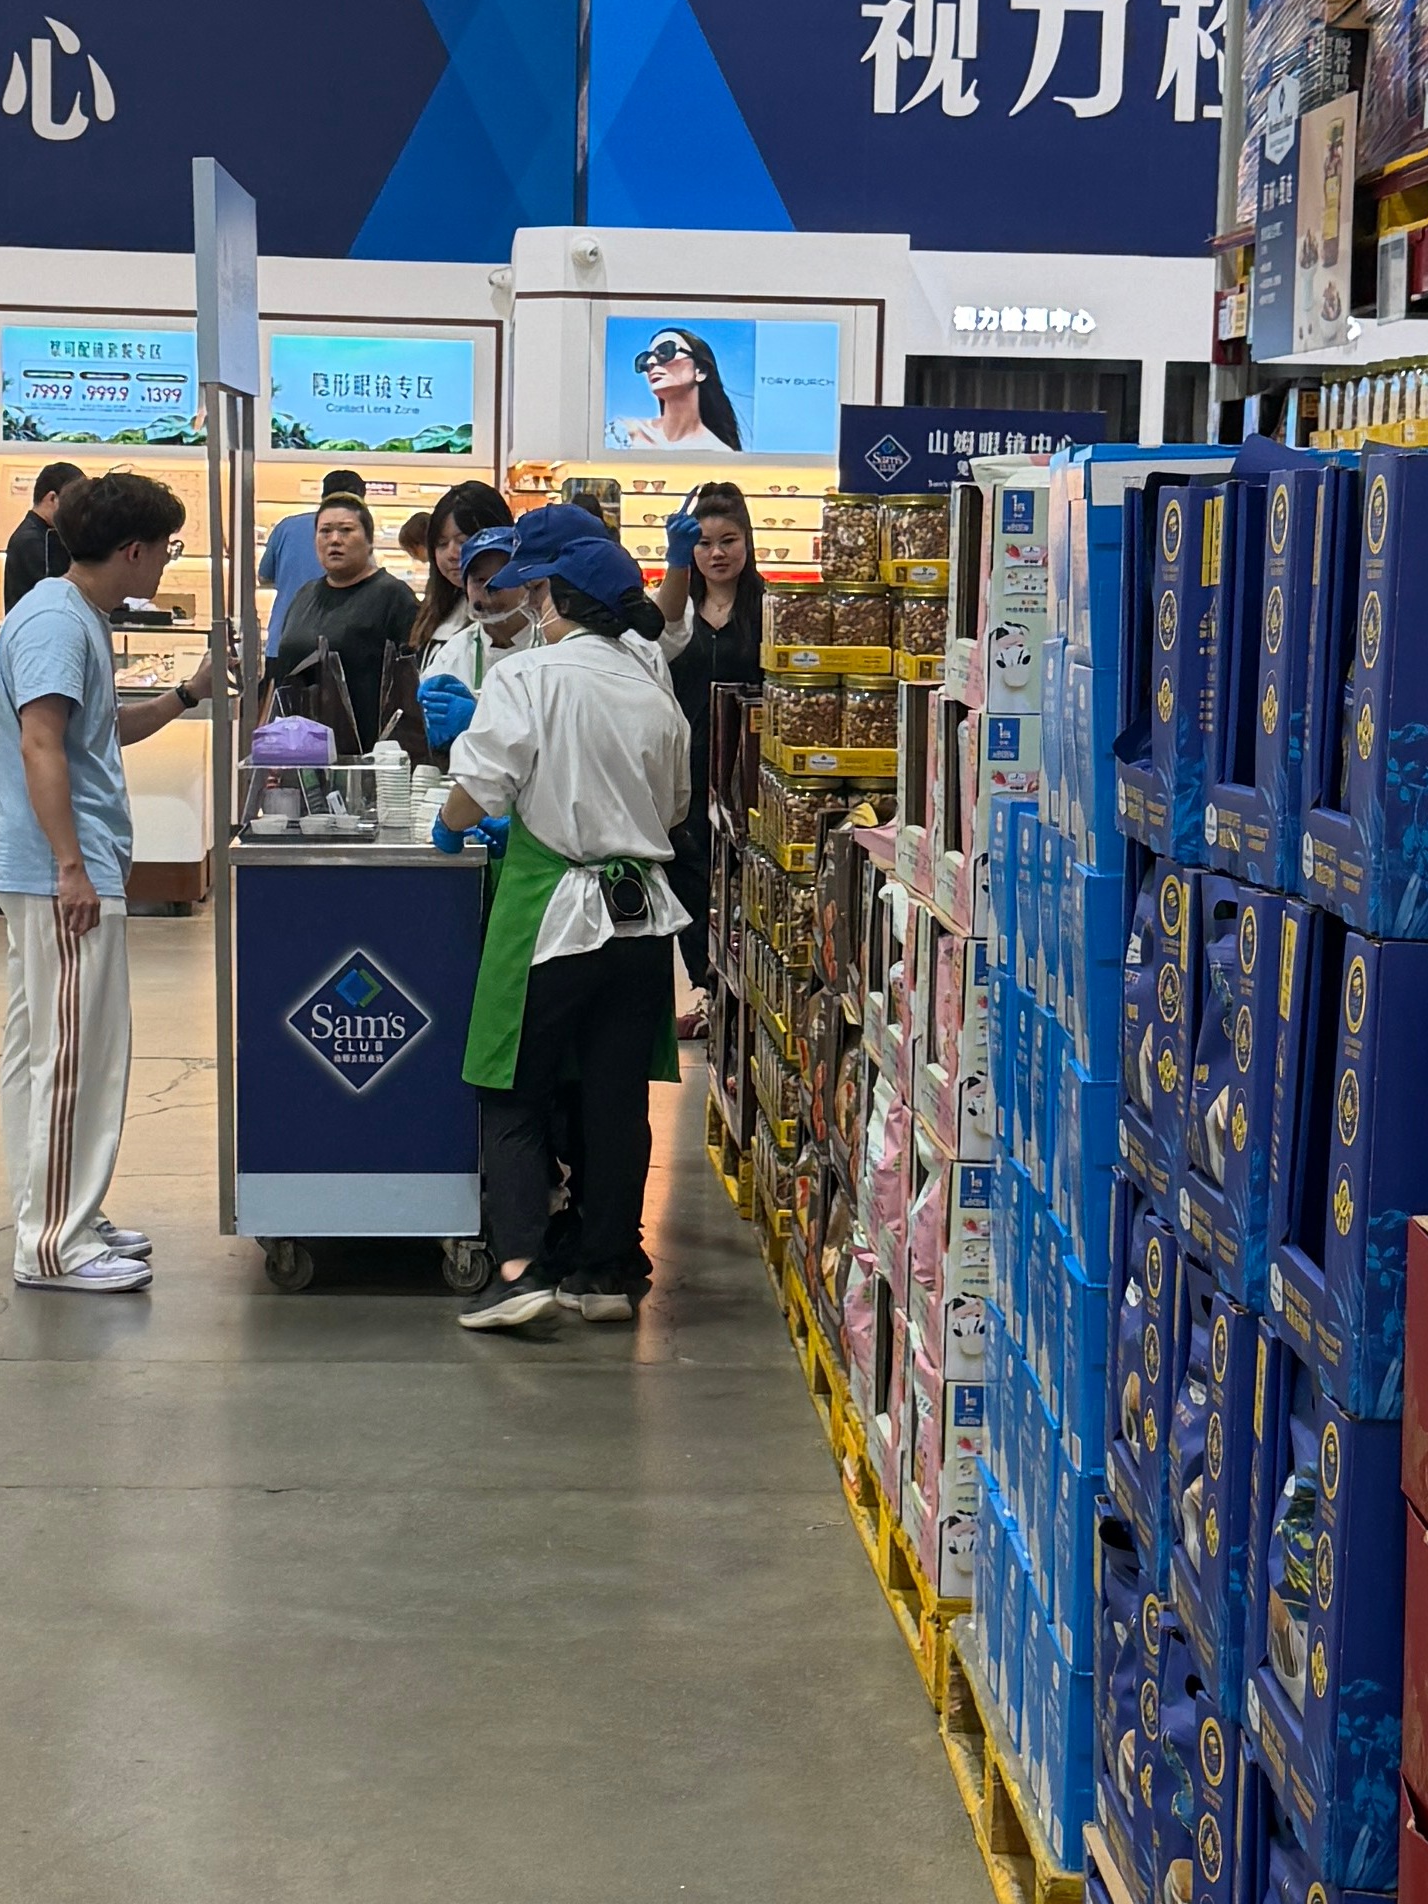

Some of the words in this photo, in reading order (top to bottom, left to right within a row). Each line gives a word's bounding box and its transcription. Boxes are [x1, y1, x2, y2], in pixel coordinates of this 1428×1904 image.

[312, 371, 434, 400] 隐形眼镜专区
[311, 1003, 406, 1039] Sam's
[334, 1040, 384, 1052] CLUB
